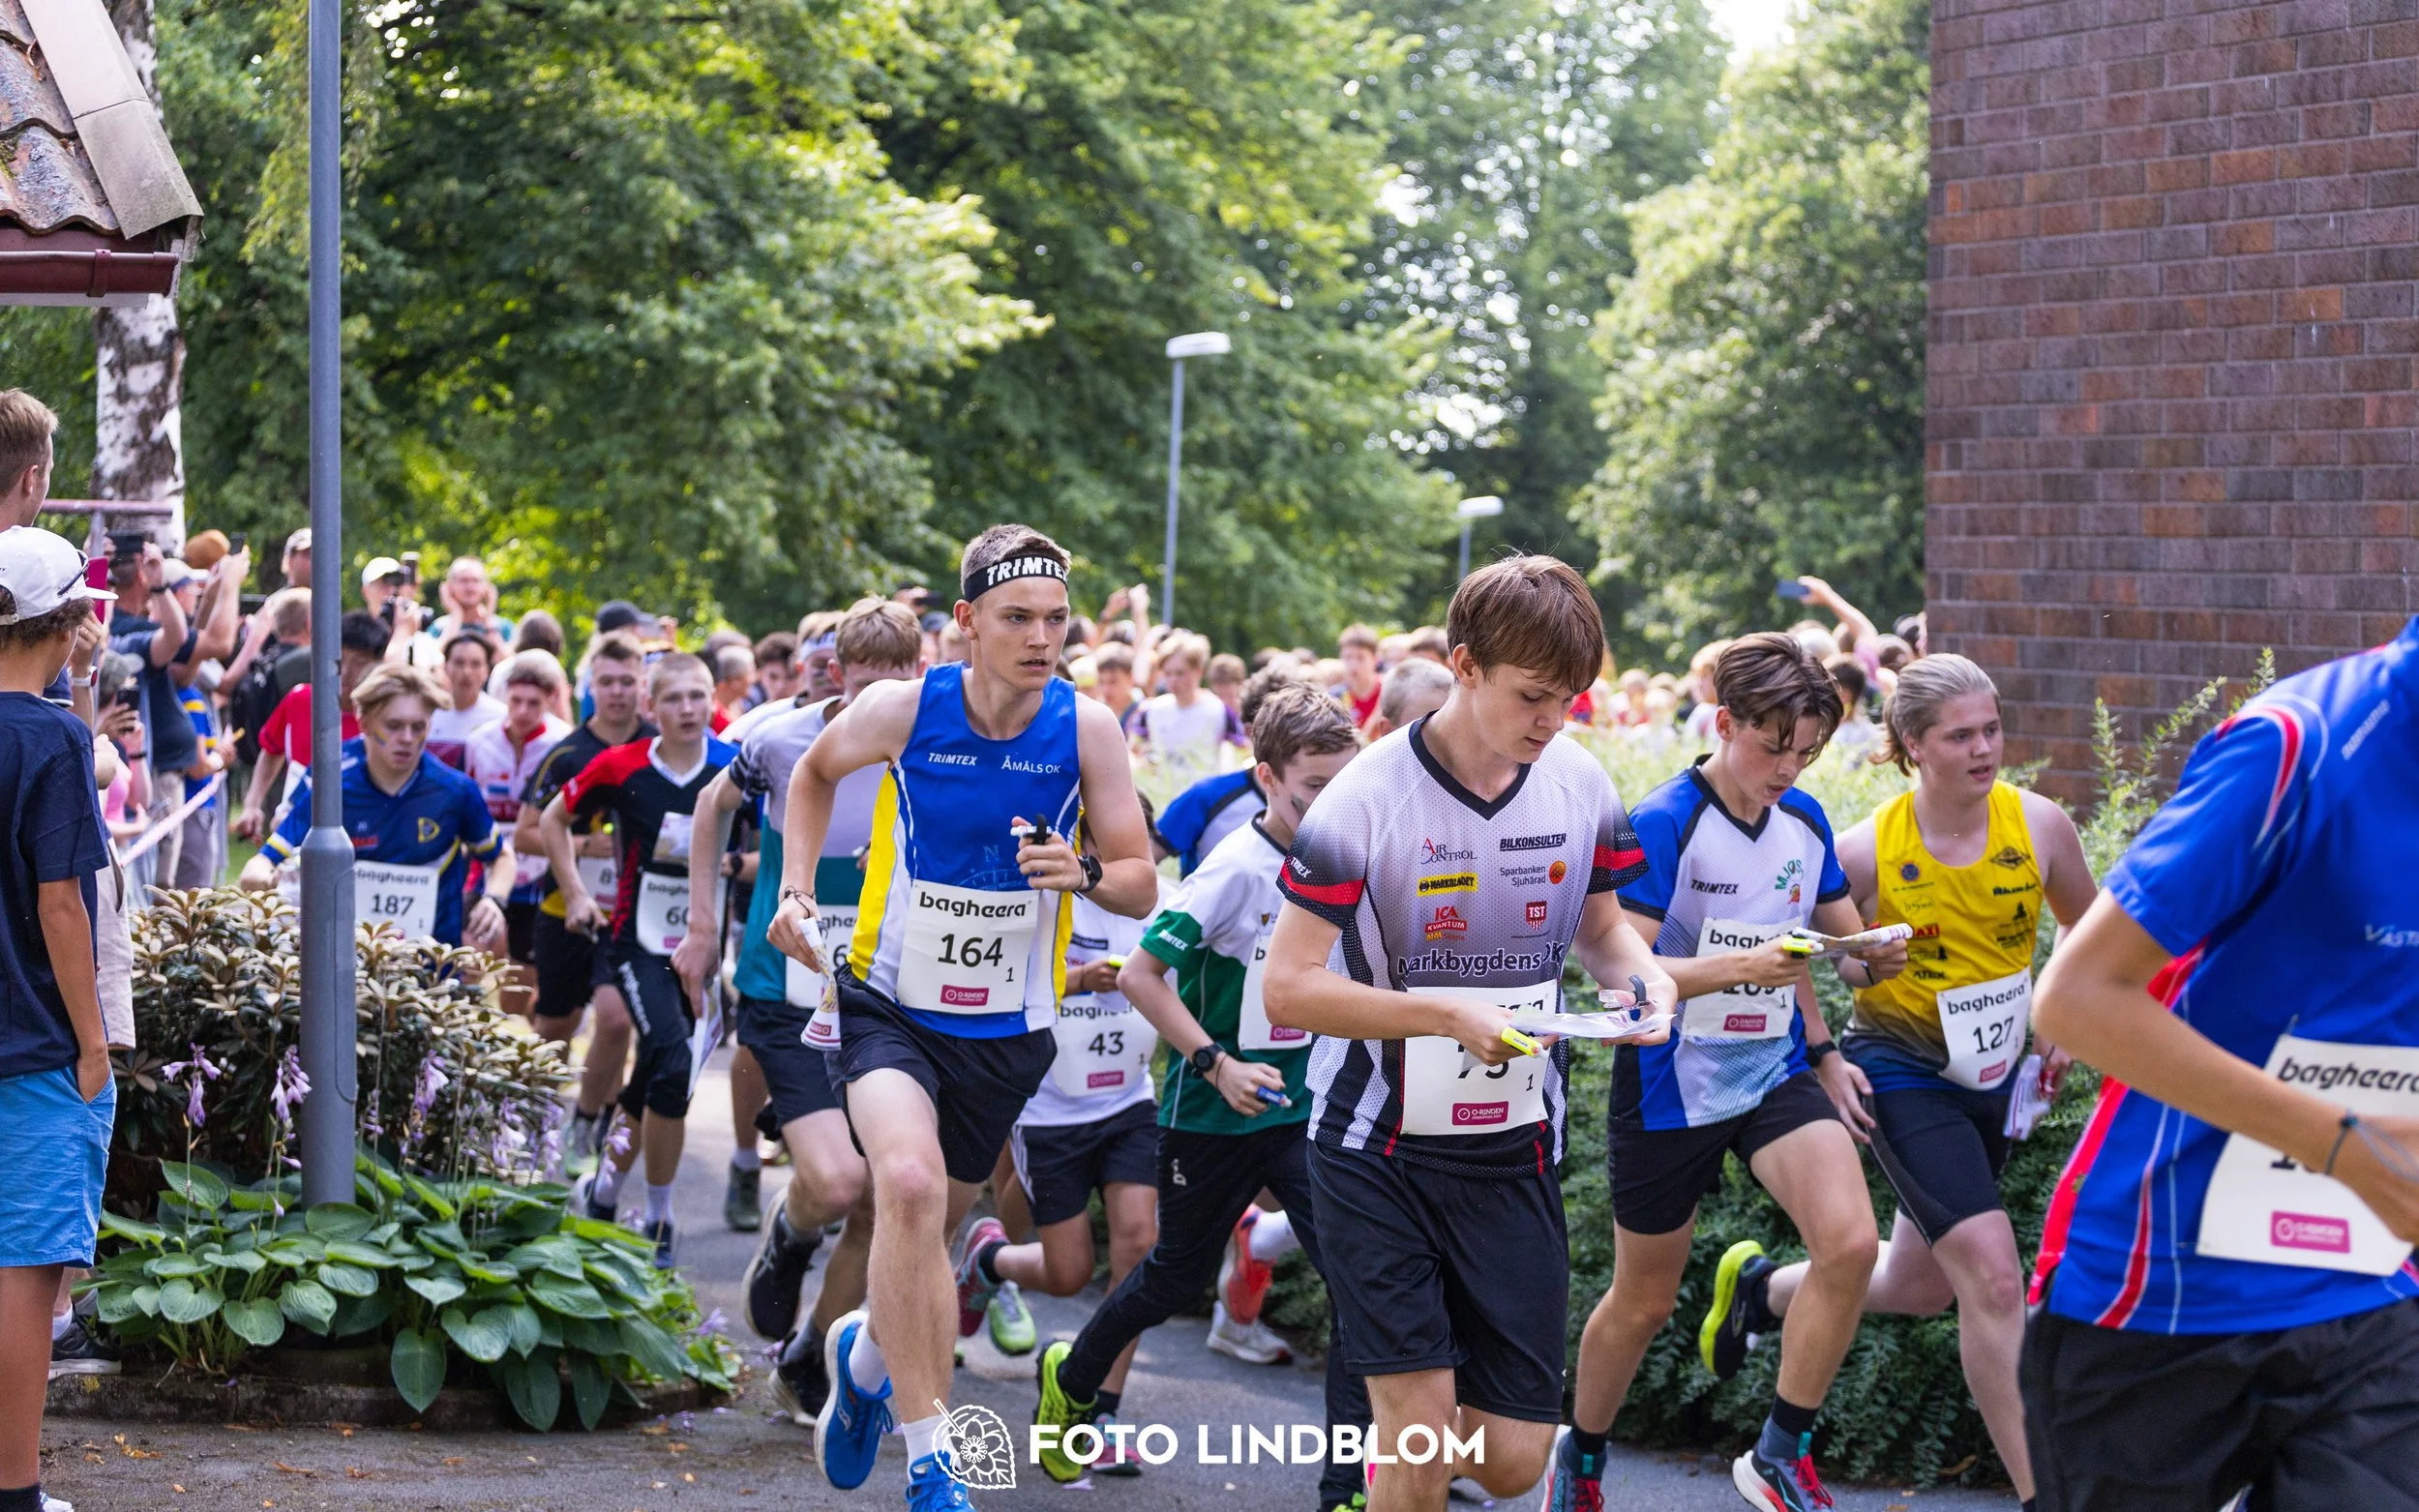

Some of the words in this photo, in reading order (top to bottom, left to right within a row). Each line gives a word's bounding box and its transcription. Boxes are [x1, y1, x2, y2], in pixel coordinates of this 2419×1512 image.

[987, 556, 1066, 586] TRIMTE
[928, 753, 977, 766] TRIMTEX
[1001, 755, 1043, 773] ÅMÅLS
[1045, 764, 1061, 774] OK
[1500, 833, 1567, 850] BILKONSULTEN
[982, 845, 1000, 863] N
[1500, 866, 1546, 876] Sparbanken
[1511, 875, 1546, 887] Sjuhärad
[1690, 879, 1739, 895] TRIMTEX
[372, 893, 415, 915] 187
[918, 891, 1027, 917] bagheera
[1435, 904, 1458, 921] ICA
[1529, 905, 1545, 918] TST
[1427, 920, 1466, 931] KVANTUM
[938, 933, 1003, 967] 164
[1005, 966, 1014, 983] 1
[1779, 993, 1787, 1008] 1
[1947, 984, 2025, 1015] bagheera
[1089, 1030, 1124, 1056] 43
[1972, 1015, 2015, 1054] 127
[1138, 1052, 1145, 1064] 1
[1526, 1074, 1534, 1091] 1
